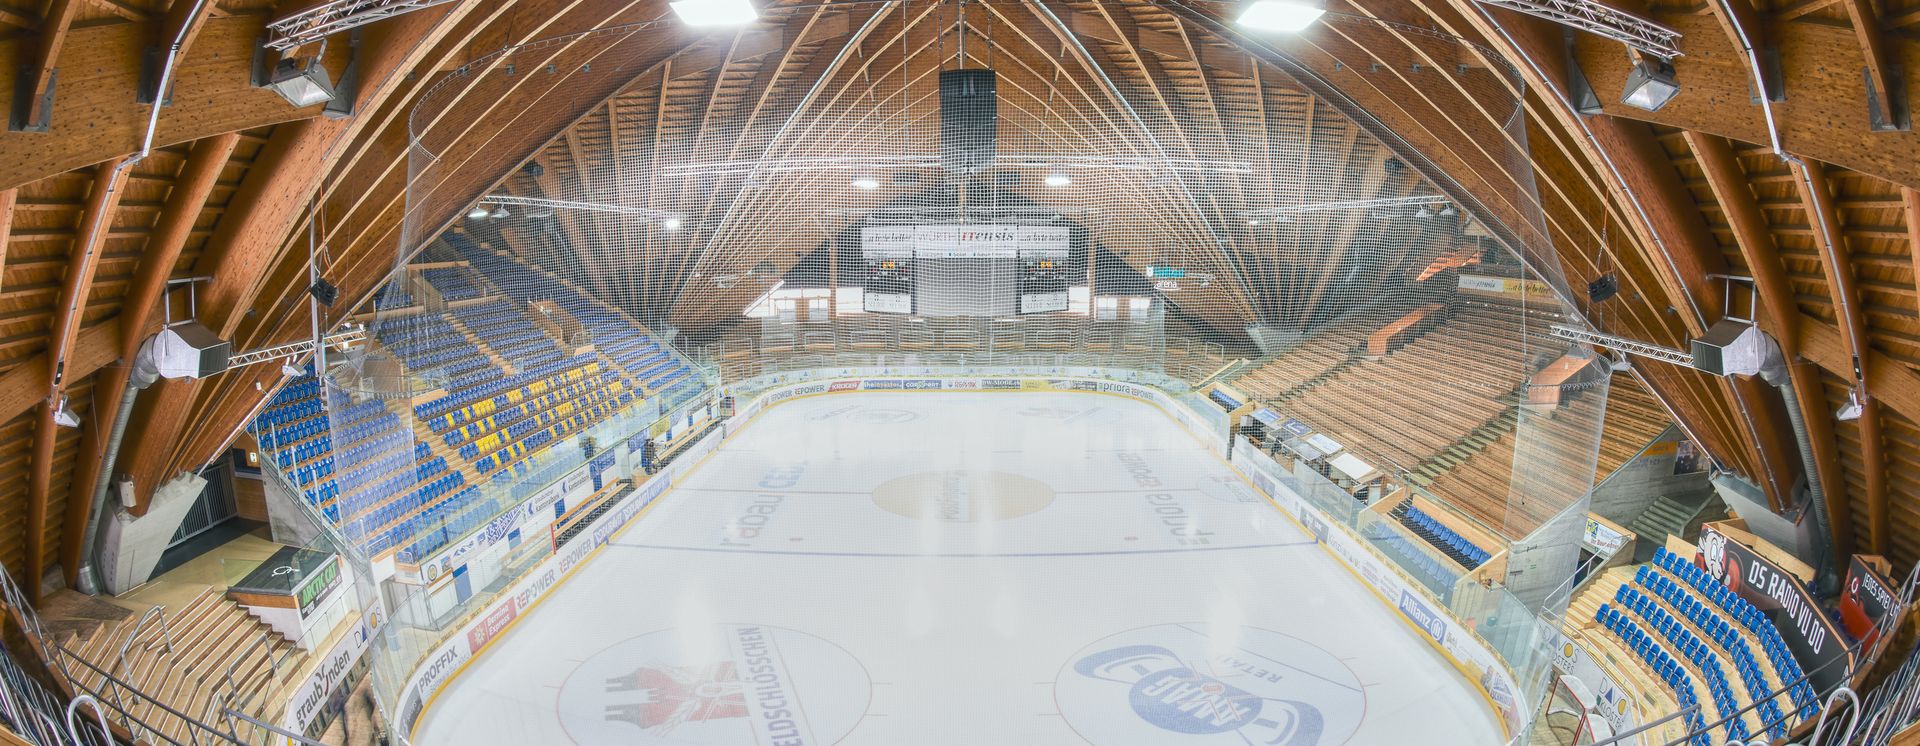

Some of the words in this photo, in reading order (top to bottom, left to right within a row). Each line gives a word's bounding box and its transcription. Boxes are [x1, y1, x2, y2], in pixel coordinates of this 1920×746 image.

[1402, 594, 1431, 629] Allianz
[1749, 559, 1766, 590] DS
[1767, 572, 1800, 619] RADIO
[1797, 595, 1812, 637] VU
[1808, 617, 1826, 655] DO
[418, 645, 458, 693] PROFFIX
